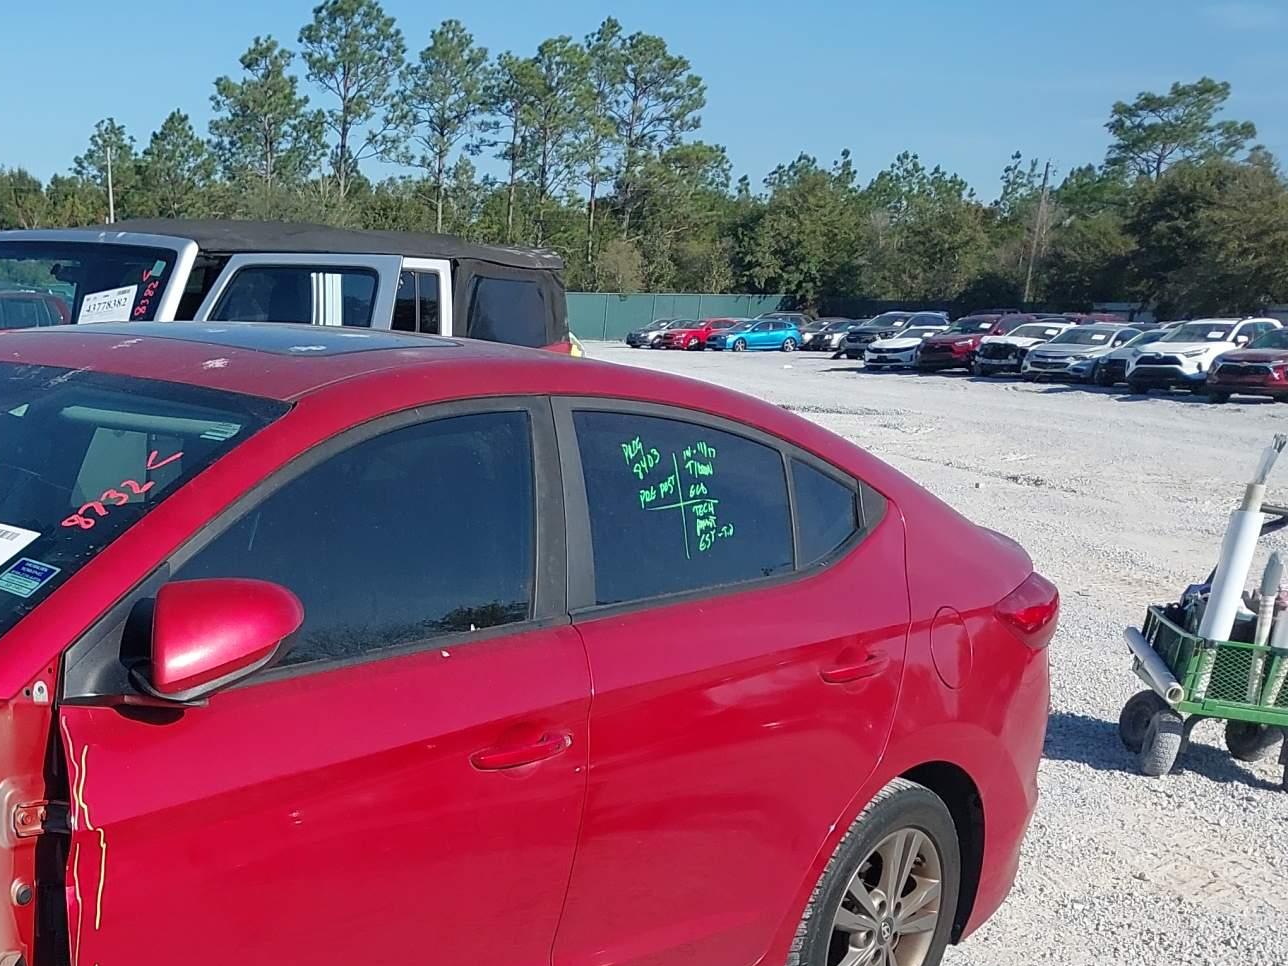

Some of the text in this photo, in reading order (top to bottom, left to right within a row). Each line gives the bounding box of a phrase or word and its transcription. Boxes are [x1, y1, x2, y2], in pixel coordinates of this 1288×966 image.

[86, 297, 128, 312] 43778382
[633, 448, 660, 480] 8403
[61, 480, 156, 529] 8732
